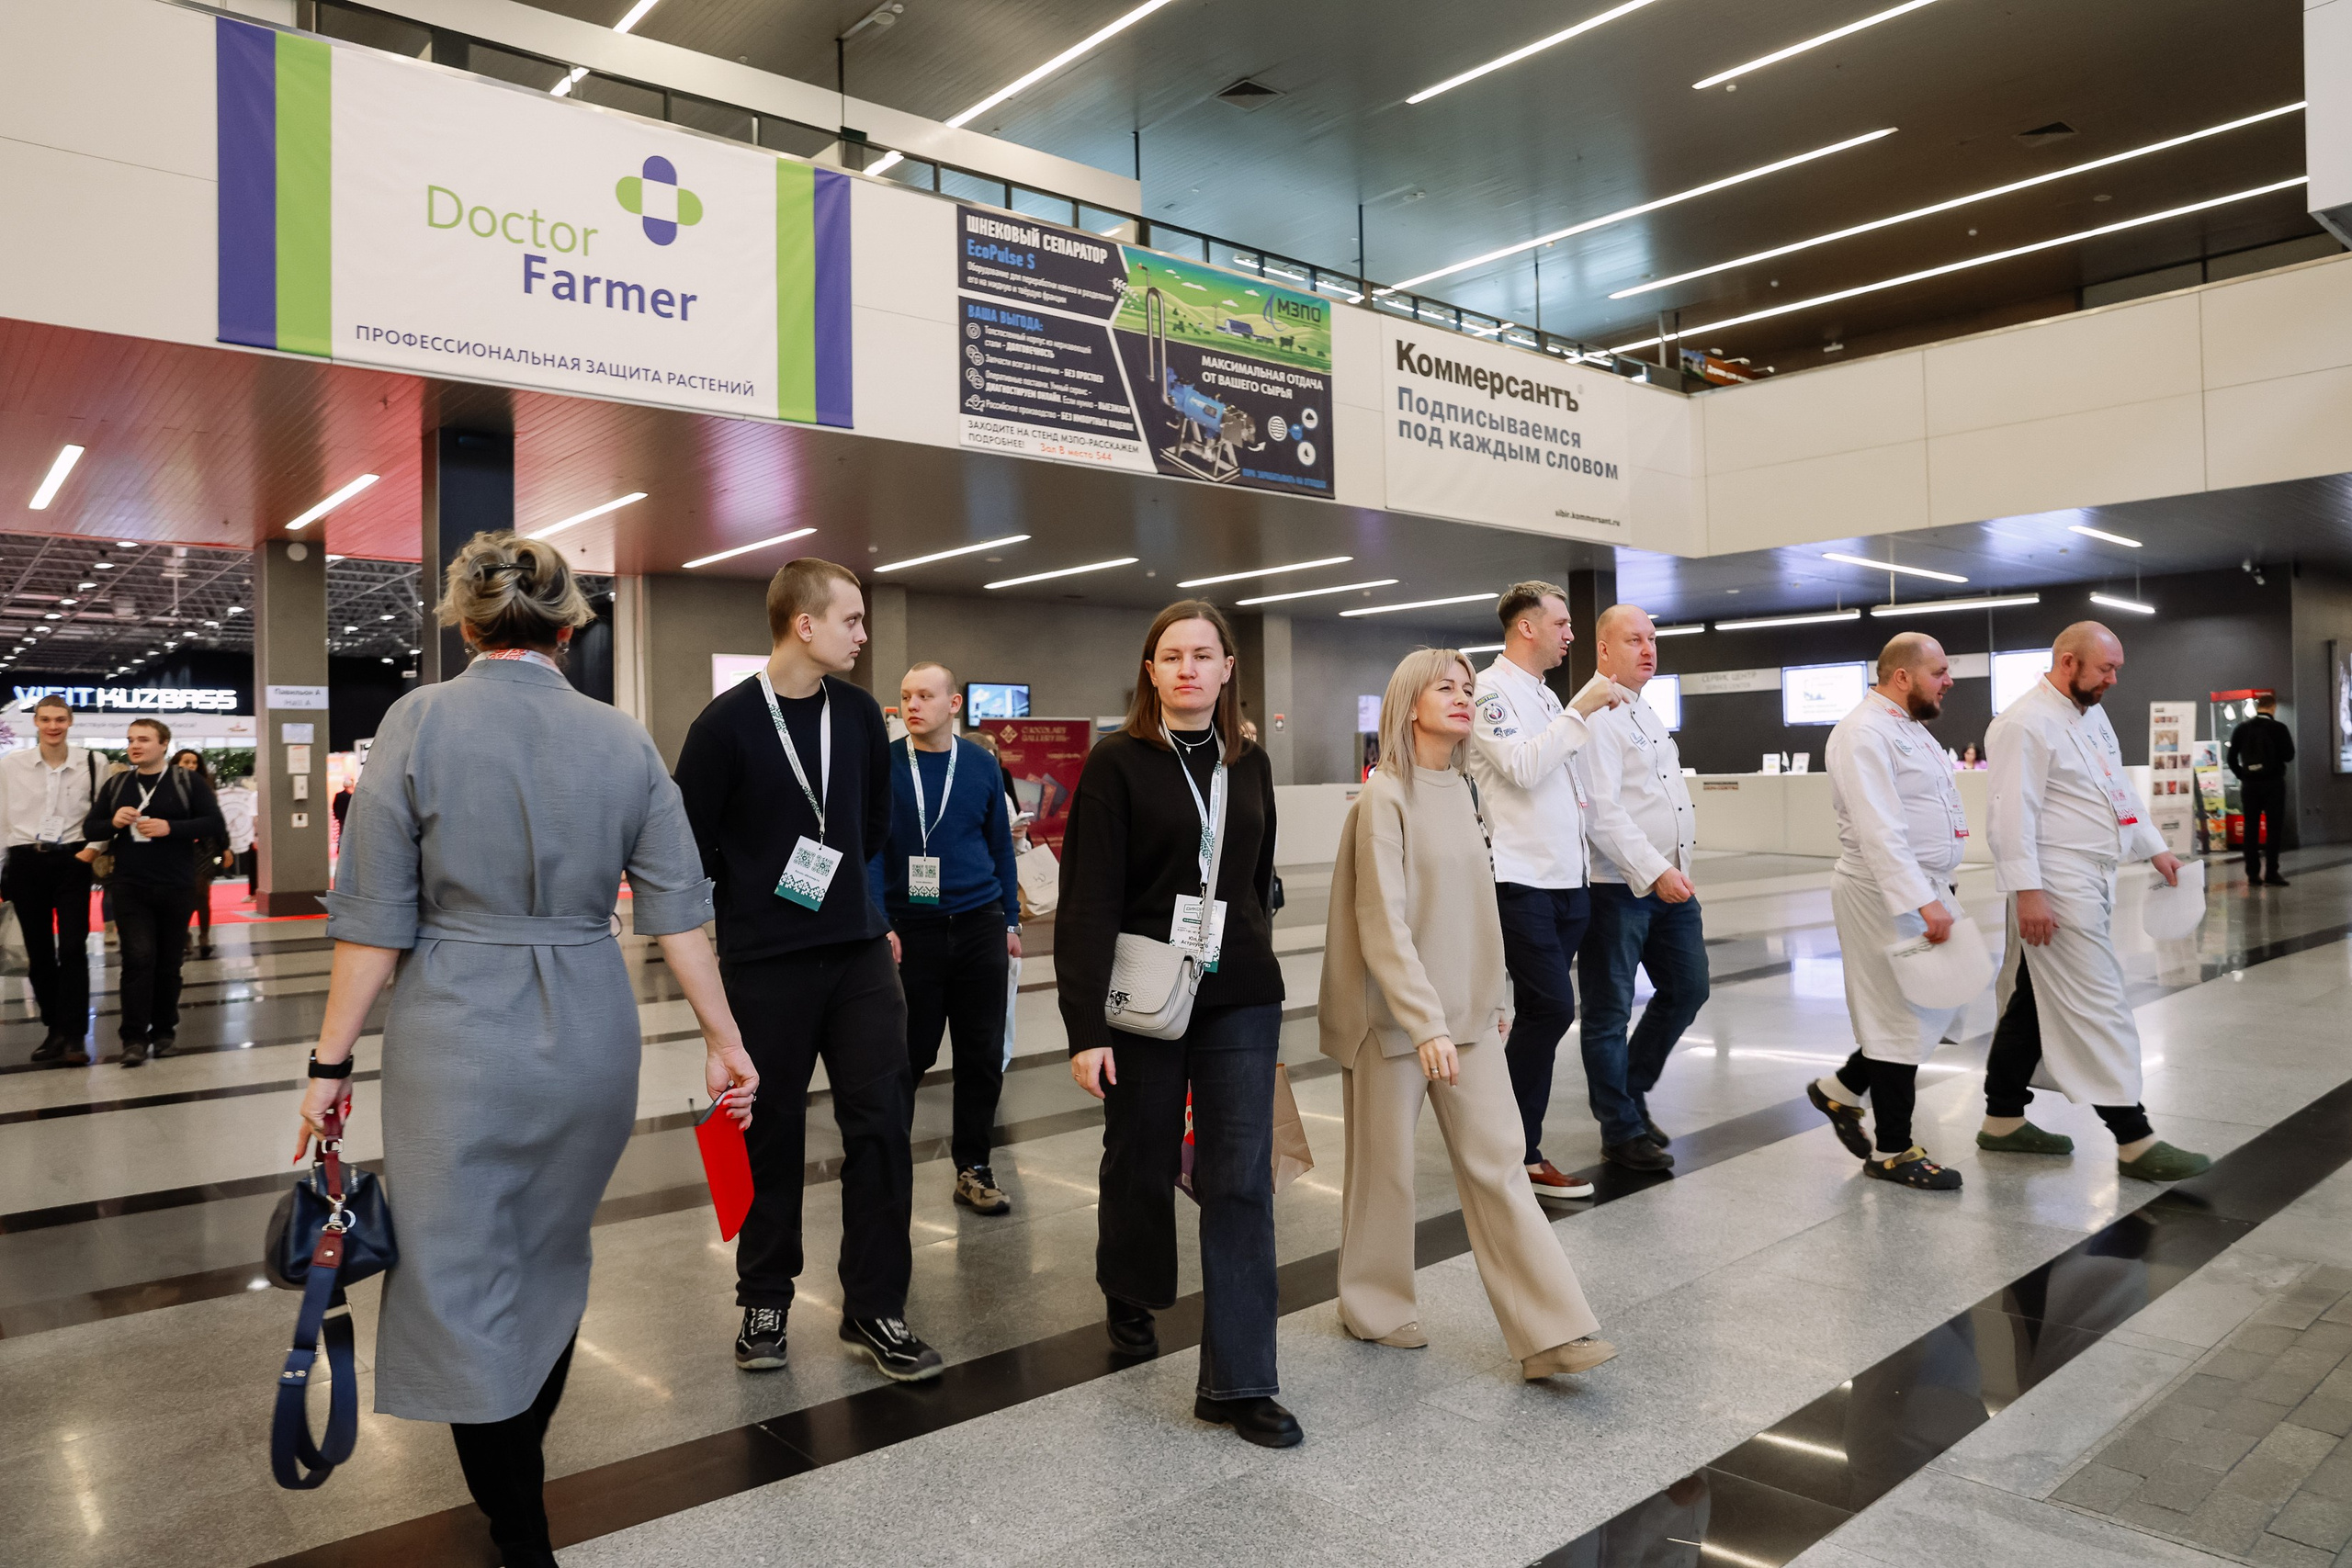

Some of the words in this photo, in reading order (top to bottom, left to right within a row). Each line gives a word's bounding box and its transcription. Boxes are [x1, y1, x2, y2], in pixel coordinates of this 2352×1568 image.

[426, 185, 599, 256] Doctor
[967, 214, 1040, 249] ШНЕКОВЫЙ
[1043, 234, 1108, 265] СЕПАРАТОР
[967, 239, 1023, 267] EcoPulse
[1026, 253, 1035, 270] S
[523, 253, 698, 322] Farmer
[967, 304, 998, 322] ВАША
[1000, 310, 1044, 332] ВЫГОДА:
[1277, 298, 1321, 322] МЗПО
[356, 324, 582, 372] ПРОФЕССИОНАЛЬНАЯ
[585, 357, 662, 385] ЗАЩИТА
[667, 370, 755, 397] РАСТЕНИЙ
[1201, 355, 1286, 382] МАКСИМАЛЬНАЯ
[1287, 373, 1324, 390] ОТДАЧА
[1396, 339, 1579, 412] Коммерсантъ
[1202, 371, 1216, 383] ОТ
[1217, 374, 1260, 392] ВАШЕГО
[1261, 383, 1293, 399] СЫРЬЯ
[1397, 386, 1581, 448] Подписываемся
[968, 420, 1014, 434] ЗАХОДИТЕ
[1017, 427, 1029, 438] НА
[1032, 429, 1058, 442] СТЕНД
[1061, 434, 1139, 453] МЗПО-РАССКАЖЕМ
[968, 434, 1025, 448] ПОДРОБНЕЕ!
[1040, 443, 1057, 455] Зал
[1068, 448, 1093, 459] место
[1096, 451, 1112, 460] 544
[1398, 419, 1443, 449] под
[1449, 430, 1541, 465] каждым
[1546, 450, 1619, 480] словом
[96, 687, 238, 710] KUZBASS
[1476, 693, 1498, 706] METRO
